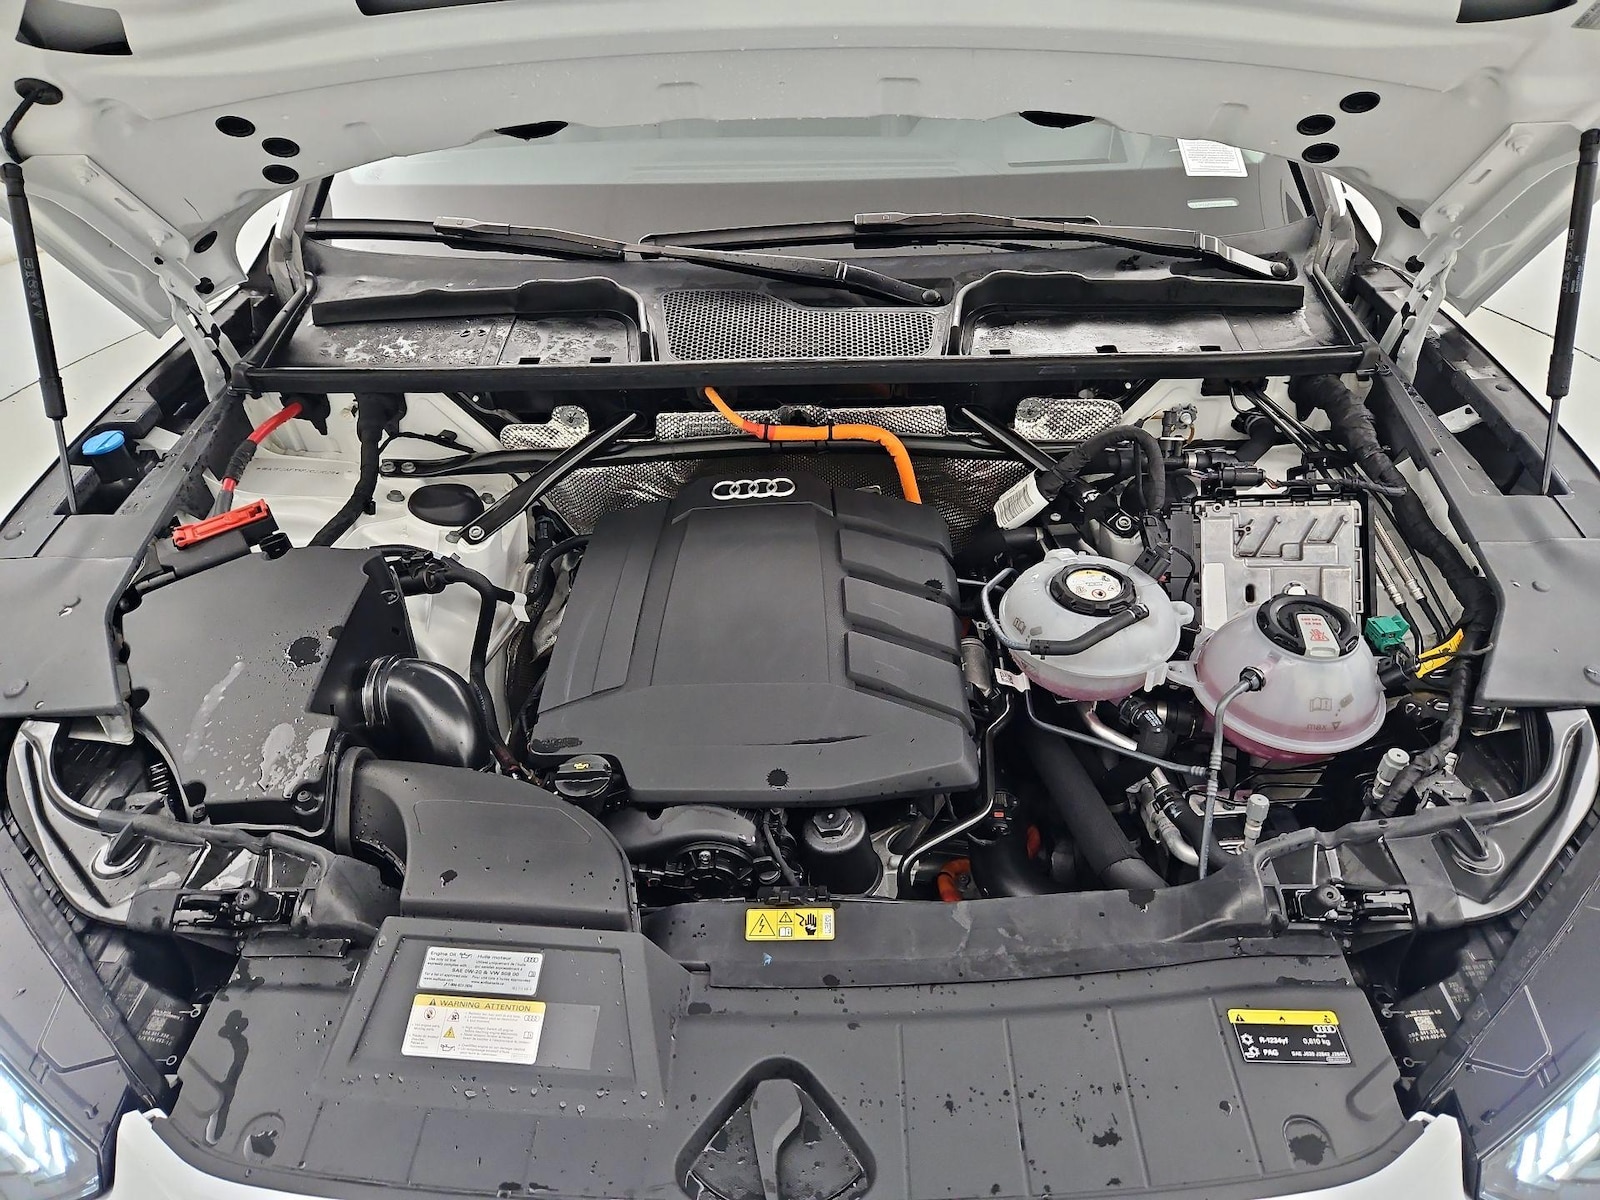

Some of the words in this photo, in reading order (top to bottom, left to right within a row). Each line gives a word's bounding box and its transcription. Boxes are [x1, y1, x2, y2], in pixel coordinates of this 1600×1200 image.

[440, 1000, 480, 1008] WARNING
[485, 1002, 531, 1012] ATTENTION
[1321, 1038, 1331, 1046] kg
[1263, 1048, 1279, 1056] PAG
